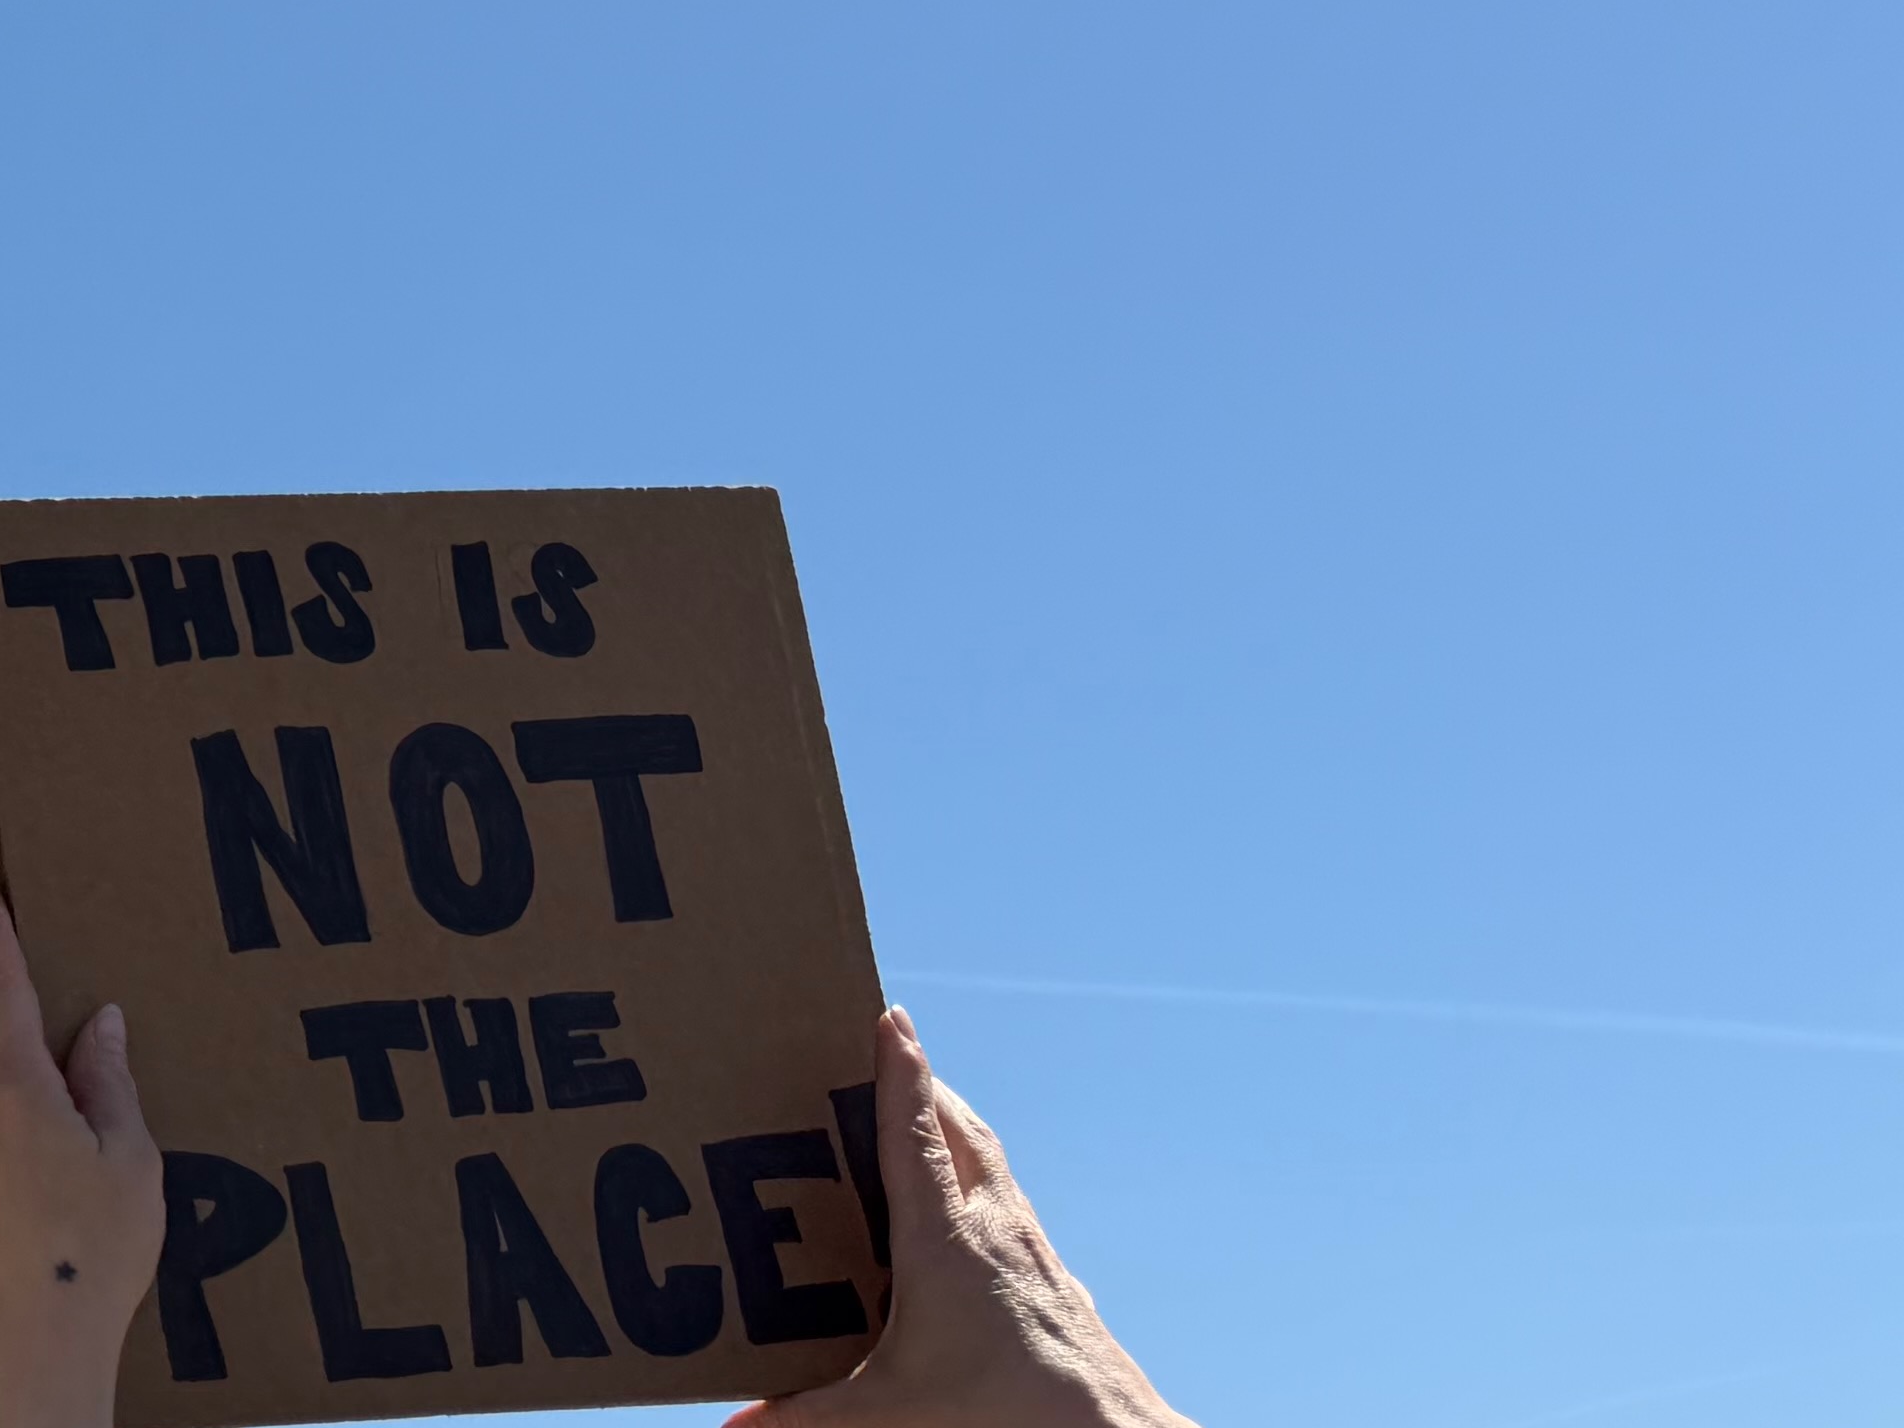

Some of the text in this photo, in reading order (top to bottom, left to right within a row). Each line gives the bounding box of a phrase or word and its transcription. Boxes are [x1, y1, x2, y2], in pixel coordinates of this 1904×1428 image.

[1, 541, 598, 671] THIS IS
[191, 714, 702, 953] NOT
[299, 991, 647, 1122] THE
